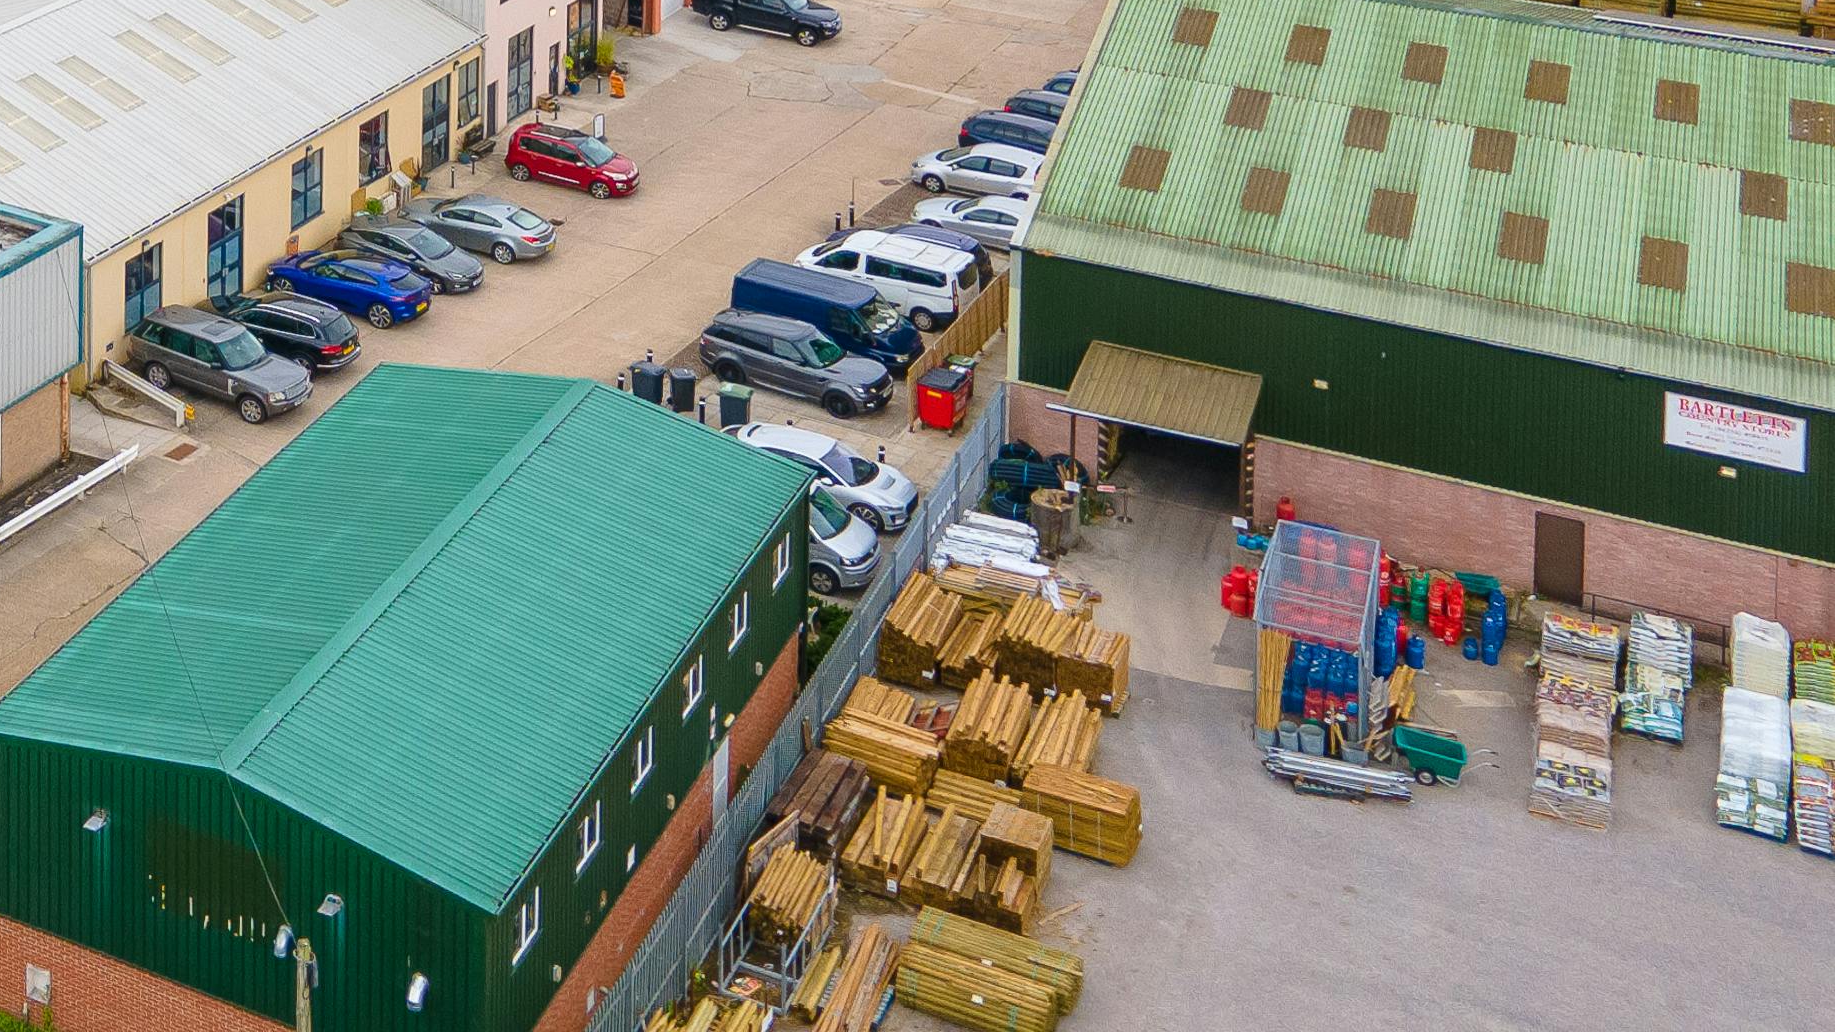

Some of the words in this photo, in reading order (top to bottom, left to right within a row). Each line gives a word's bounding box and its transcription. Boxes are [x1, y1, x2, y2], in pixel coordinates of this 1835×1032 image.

[1678, 411, 1737, 428] COUNTRY
[1743, 424, 1790, 440] STORES
[1679, 398, 1795, 432] BARTLETTS
